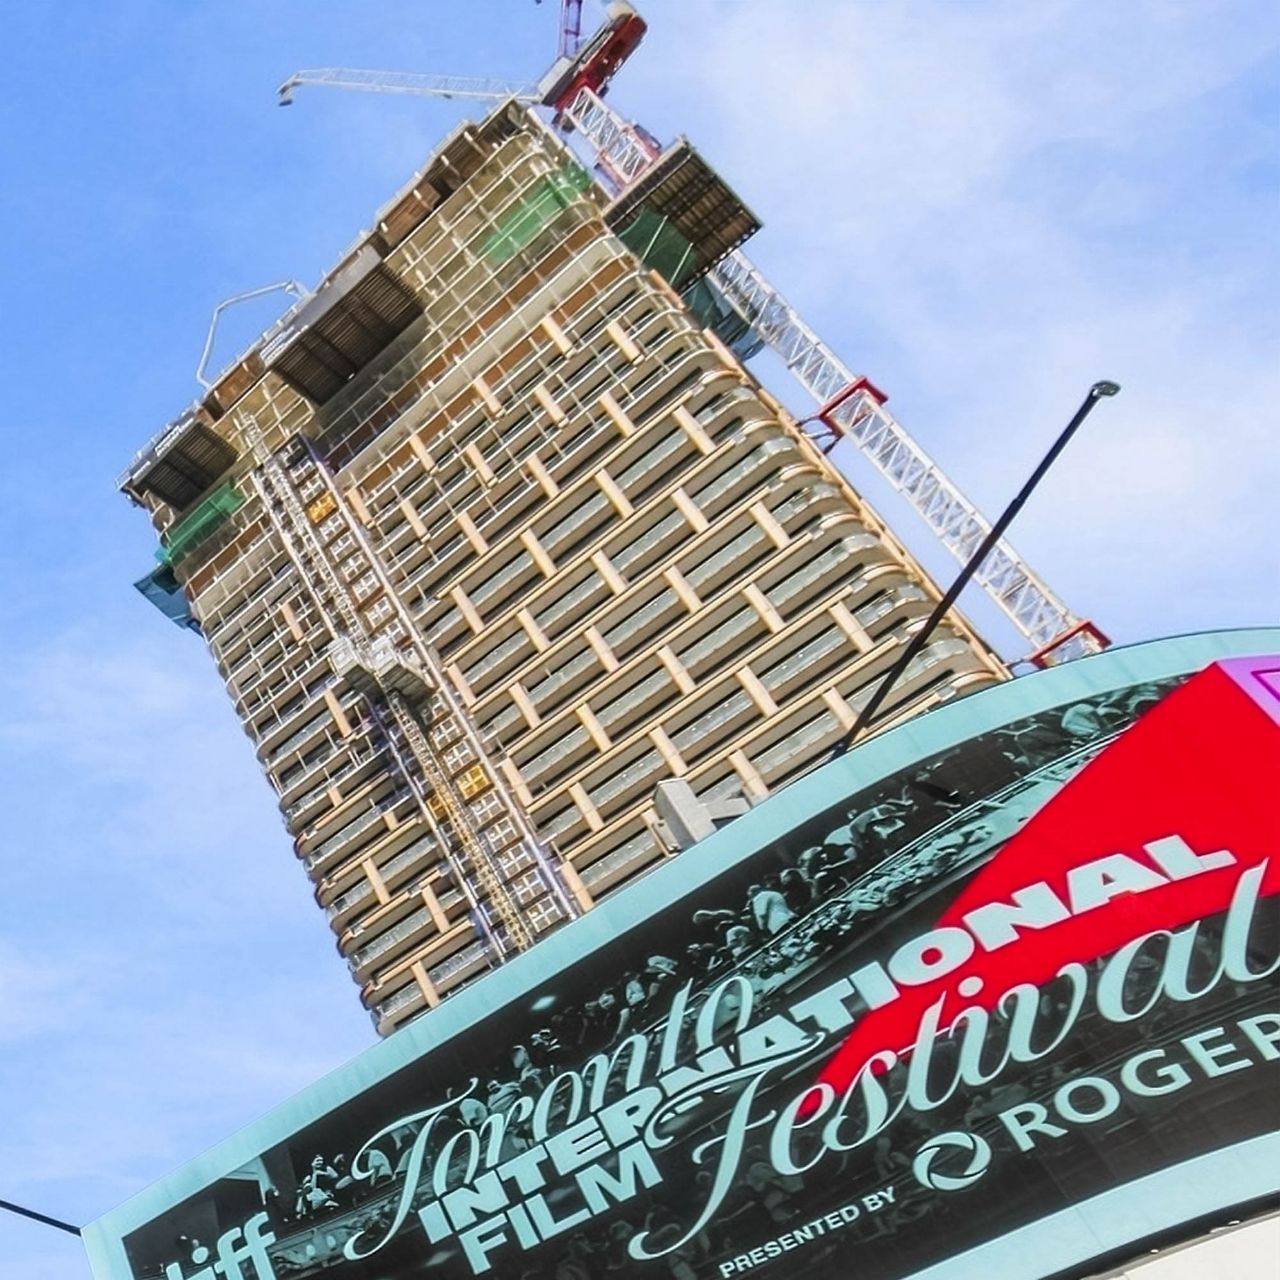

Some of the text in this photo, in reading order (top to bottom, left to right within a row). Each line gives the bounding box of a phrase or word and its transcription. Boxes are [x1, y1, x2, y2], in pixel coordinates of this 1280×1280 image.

[343, 976, 754, 1261] Toronto
[418, 835, 1238, 1245] INTERNATIONAL
[628, 857, 1280, 1261] Festival
[458, 1140, 663, 1276] FILM
[719, 1186, 897, 1279] PRESENTED BY
